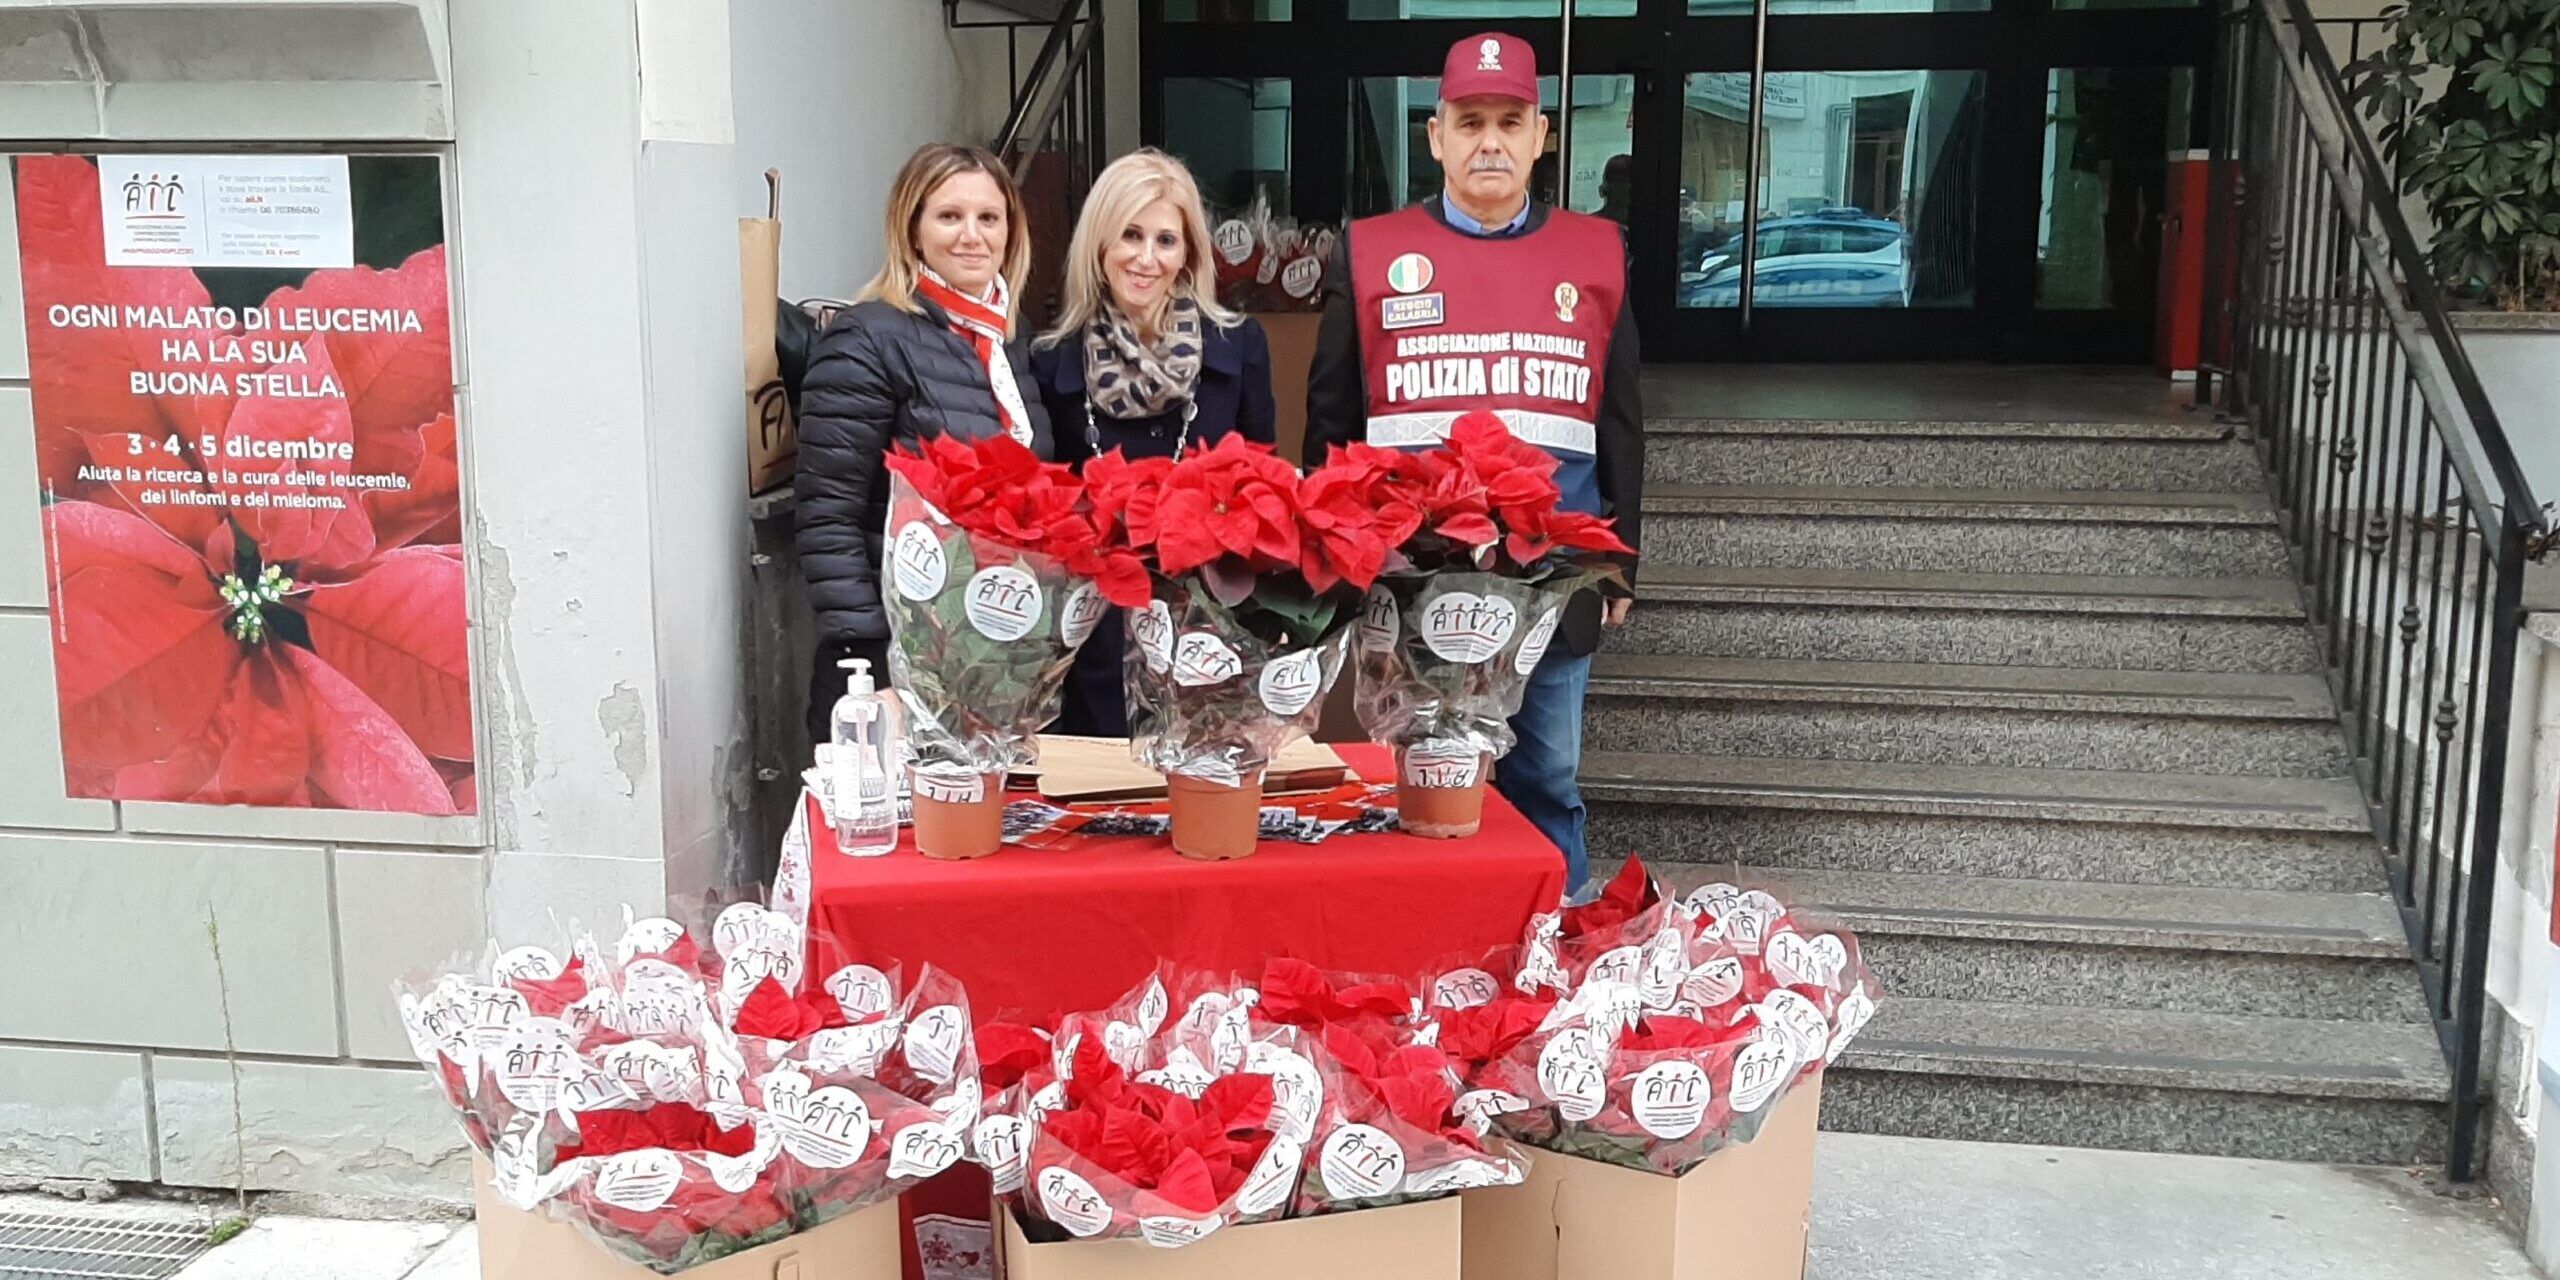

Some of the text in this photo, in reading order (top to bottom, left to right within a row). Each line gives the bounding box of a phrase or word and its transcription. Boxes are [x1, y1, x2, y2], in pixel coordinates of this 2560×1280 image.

[48, 304, 423, 333] OGNI MALATO DI LEUCEMIA
[1388, 308, 1438, 323] CALABRIA
[162, 339, 308, 364] HA LA SUA
[1397, 332, 1586, 359] ASSOCIAZIONE NAZIONALE
[130, 371, 346, 398] BUONA STELLA.
[1386, 356, 1591, 404] POLIZIA di STATO
[225, 435, 354, 460] dicembre
[77, 465, 122, 481] Aiuta
[126, 465, 141, 481] la
[145, 467, 203, 484] ricerca
[207, 472, 218, 484] e
[223, 468, 237, 484] la
[243, 472, 280, 486] cura
[285, 470, 326, 487] delle
[141, 489, 167, 504] dei
[171, 489, 227, 506] linfomi
[231, 495, 241, 506] e
[244, 491, 269, 507] del
